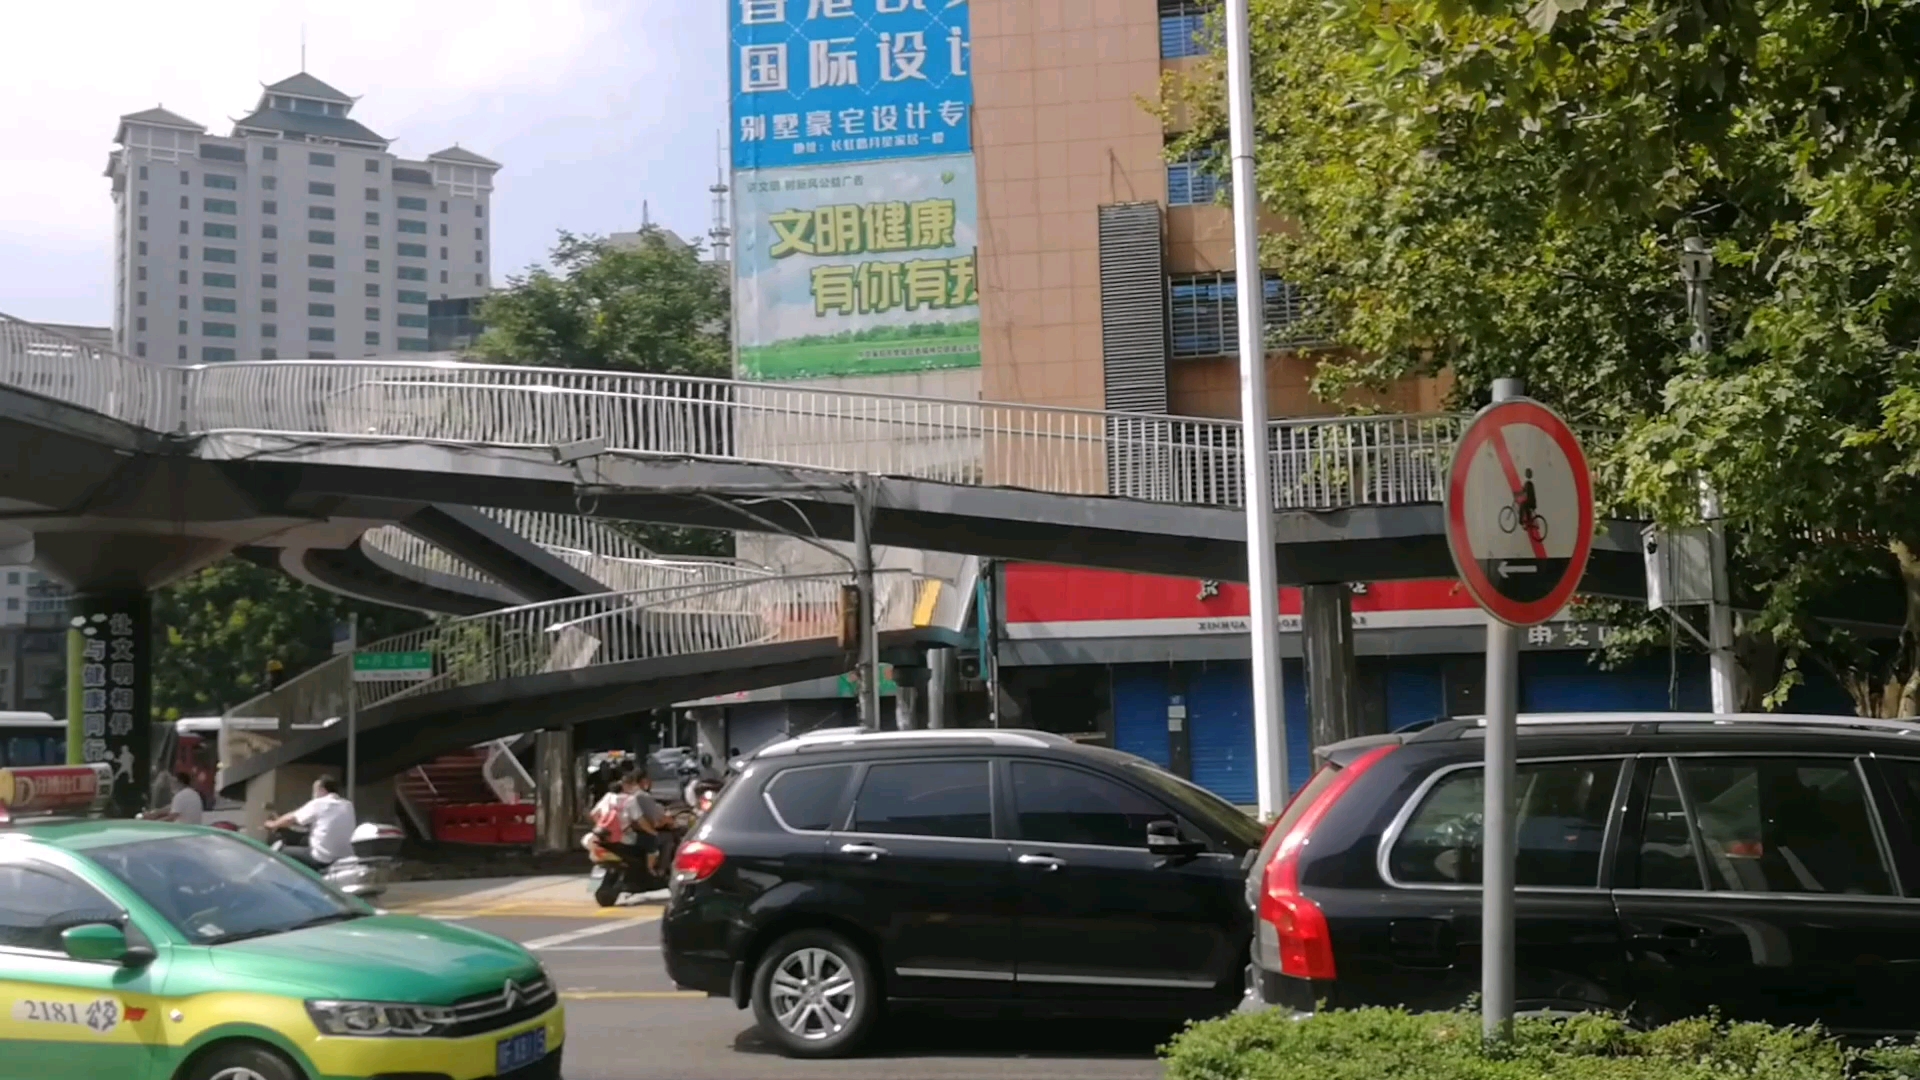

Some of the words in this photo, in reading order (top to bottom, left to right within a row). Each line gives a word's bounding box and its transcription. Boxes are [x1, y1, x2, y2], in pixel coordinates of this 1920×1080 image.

[740, 100, 965, 142] 别墅豪宅设计专
[768, 197, 955, 258] 文明健康
[24, 1000, 78, 1024] 2181
